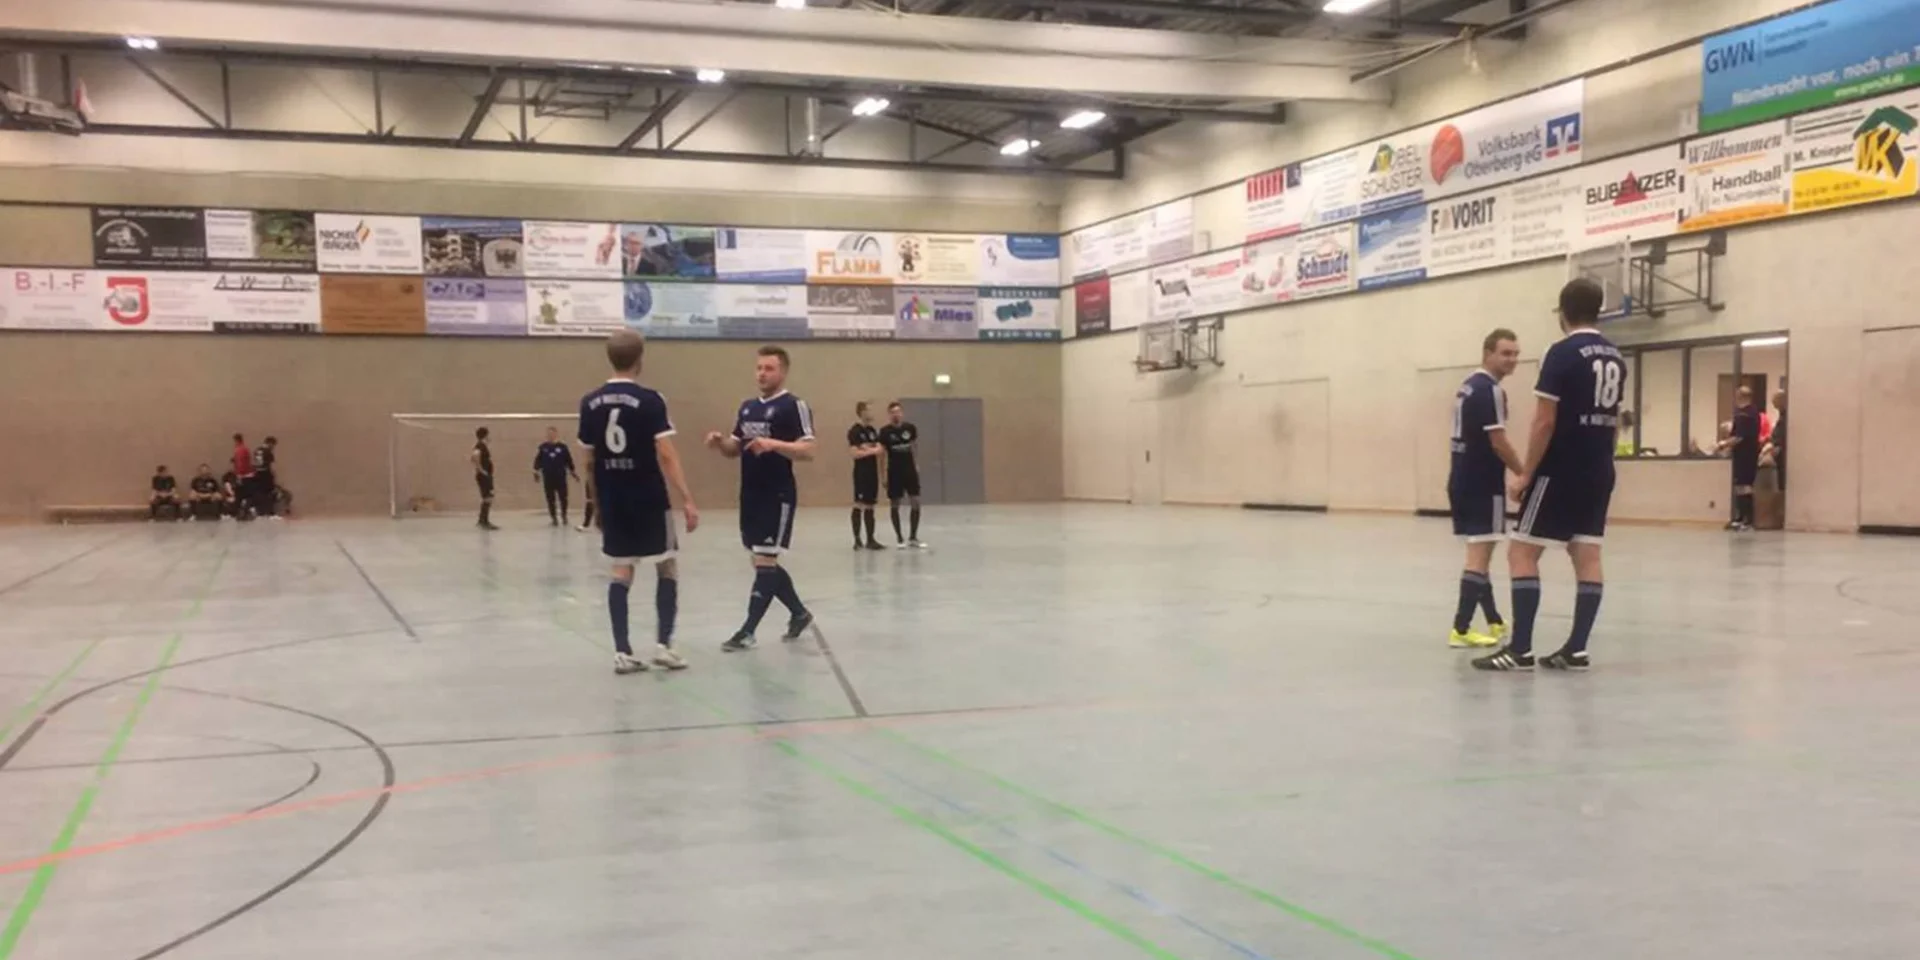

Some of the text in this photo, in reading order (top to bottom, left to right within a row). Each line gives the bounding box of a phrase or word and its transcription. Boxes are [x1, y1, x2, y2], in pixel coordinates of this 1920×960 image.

[1705, 39, 1755, 73] GWN
[1477, 126, 1542, 157] Volksbank
[1688, 134, 1782, 164] Willkommen
[1463, 145, 1543, 179] Oberberg eG
[1361, 167, 1423, 198] SCHUSTER
[1586, 169, 1677, 205] BUBENZER
[1712, 165, 1782, 191] Handball
[1431, 197, 1496, 234] FAVORIT
[817, 251, 882, 275] FLAMM
[1296, 250, 1350, 281] Schmidt
[934, 308, 974, 322] Mies
[1592, 359, 1620, 408] 18
[605, 408, 627, 453] 6
